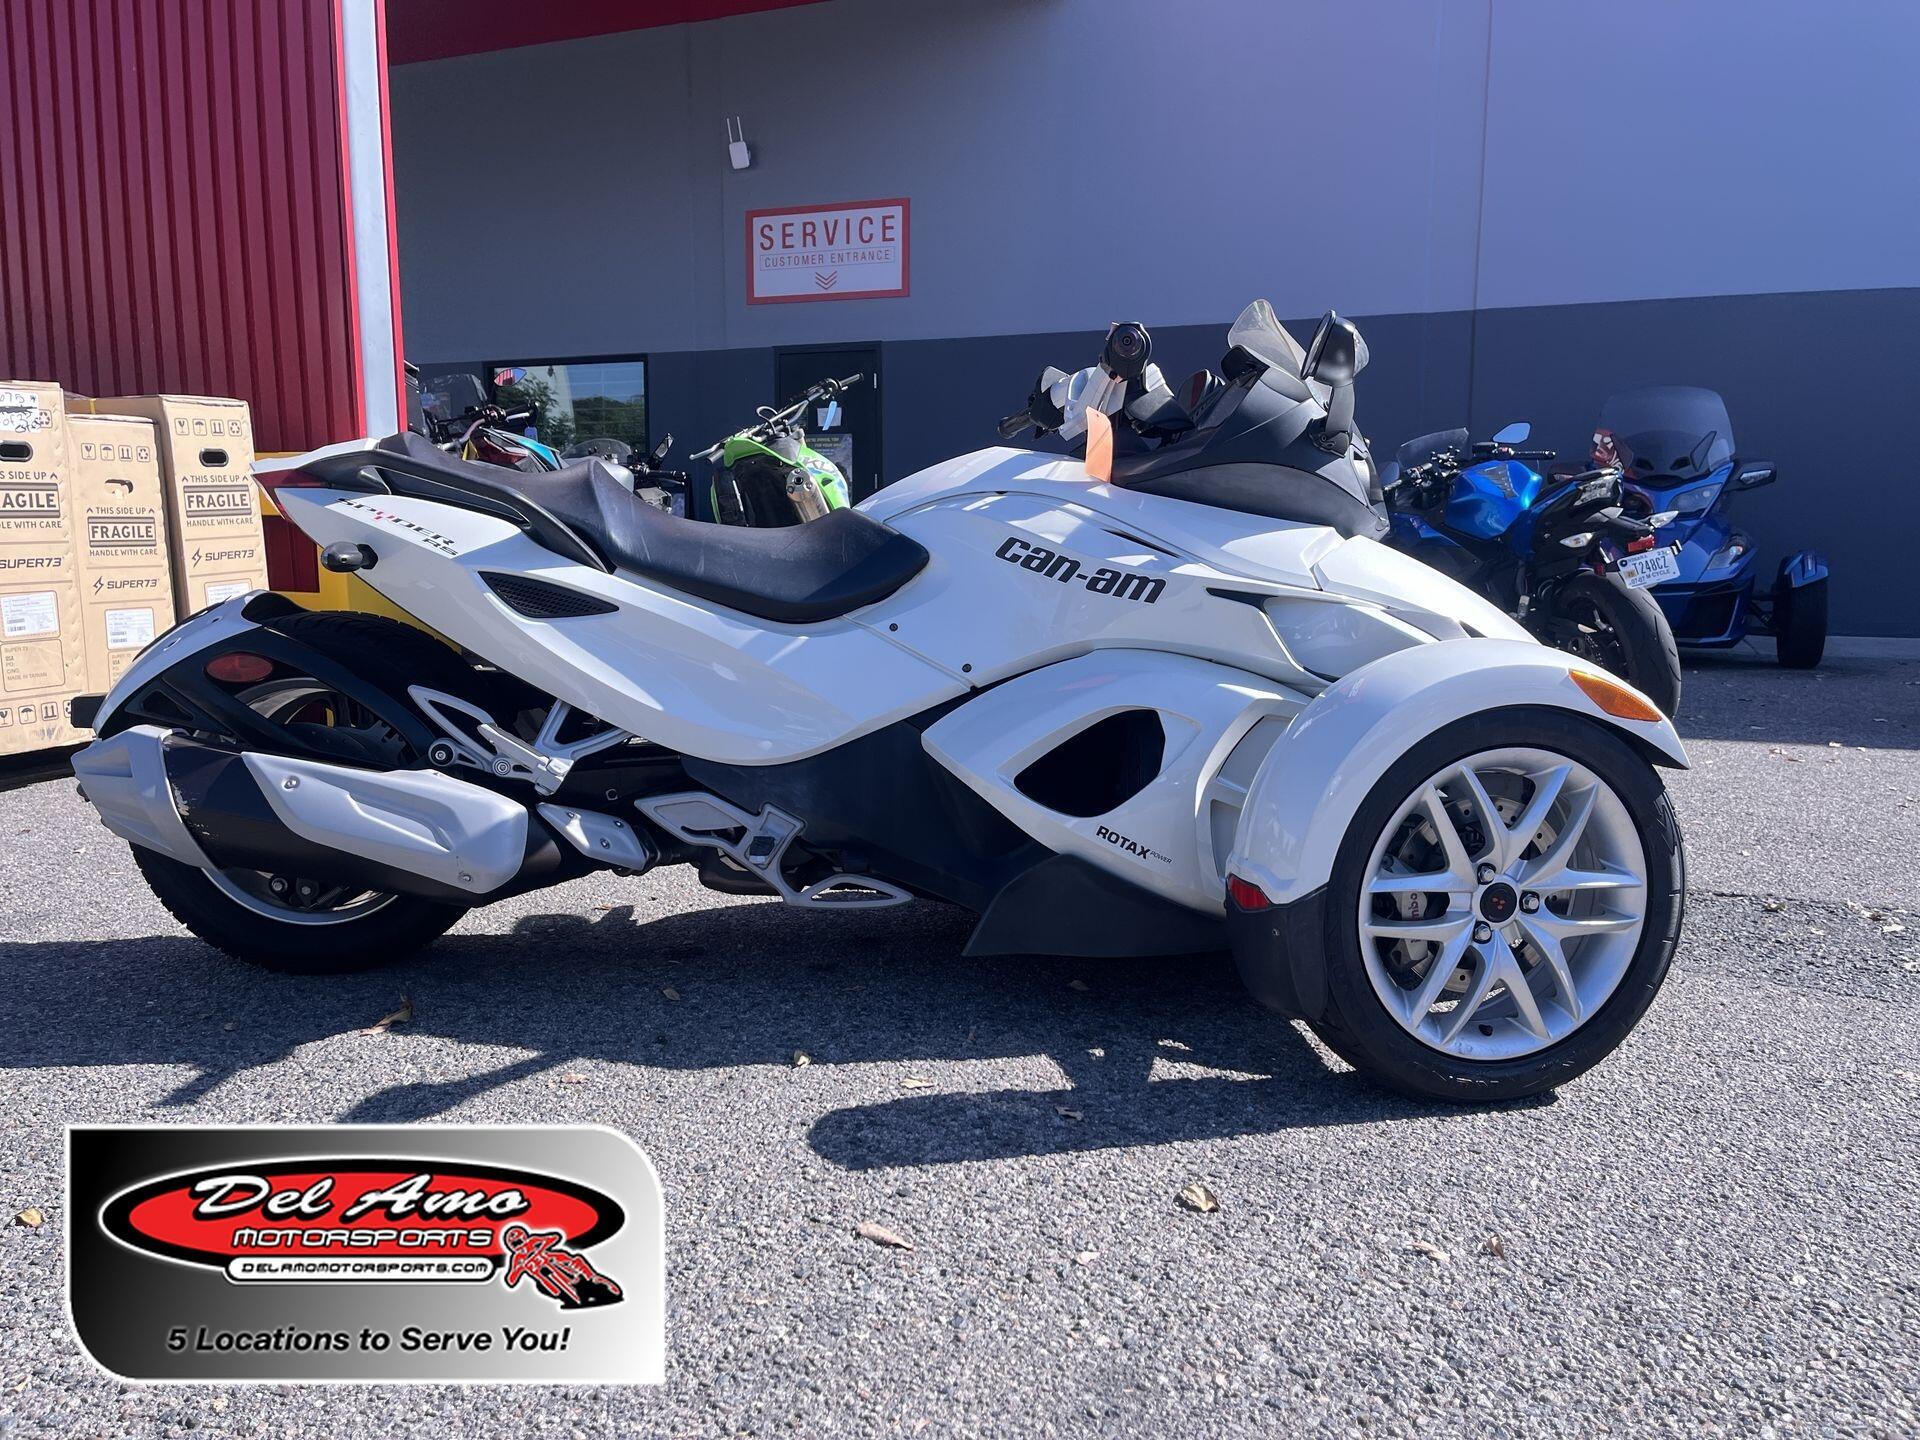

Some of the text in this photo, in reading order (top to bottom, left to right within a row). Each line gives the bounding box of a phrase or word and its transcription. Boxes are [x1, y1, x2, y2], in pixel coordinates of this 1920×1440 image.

[759, 214, 896, 251] SERVICE
[764, 249, 890, 268] CUSTOMER ENTRANCE
[8, 471, 32, 480] SIDE
[33, 471, 47, 480] UP
[190, 475, 209, 483] THIS
[2, 492, 57, 508] AGILE
[187, 493, 249, 509] FRAGILE
[96, 506, 147, 515] THIS SIDE UP
[14, 521, 37, 529] WITH
[39, 520, 63, 529] CARE
[186, 517, 254, 527] HANDLE WITH CARE
[91, 525, 154, 539] FRAGILE
[139, 548, 158, 556] CARE
[205, 549, 255, 561] SUPER73
[0, 557, 62, 569] SUPER73
[994, 536, 1168, 604] can-am
[107, 580, 157, 590] SUPER73
[1096, 825, 1150, 860] ROTAX
